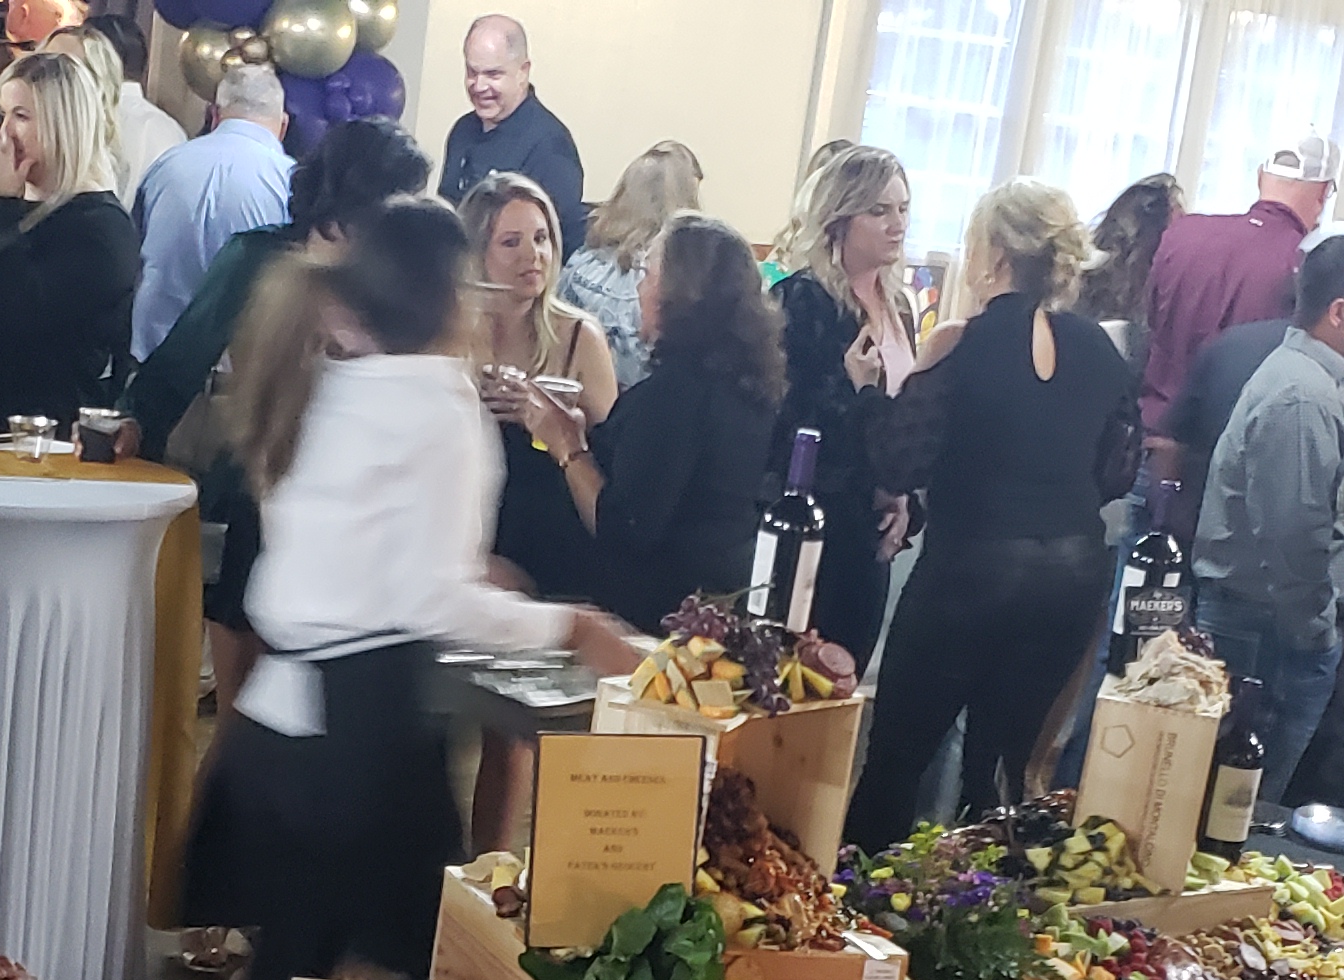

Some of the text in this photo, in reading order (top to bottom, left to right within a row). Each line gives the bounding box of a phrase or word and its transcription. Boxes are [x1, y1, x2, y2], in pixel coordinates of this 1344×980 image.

[569, 773, 598, 783] MEAT
[601, 774, 622, 783] AND
[1156, 788, 1166, 800] DI
